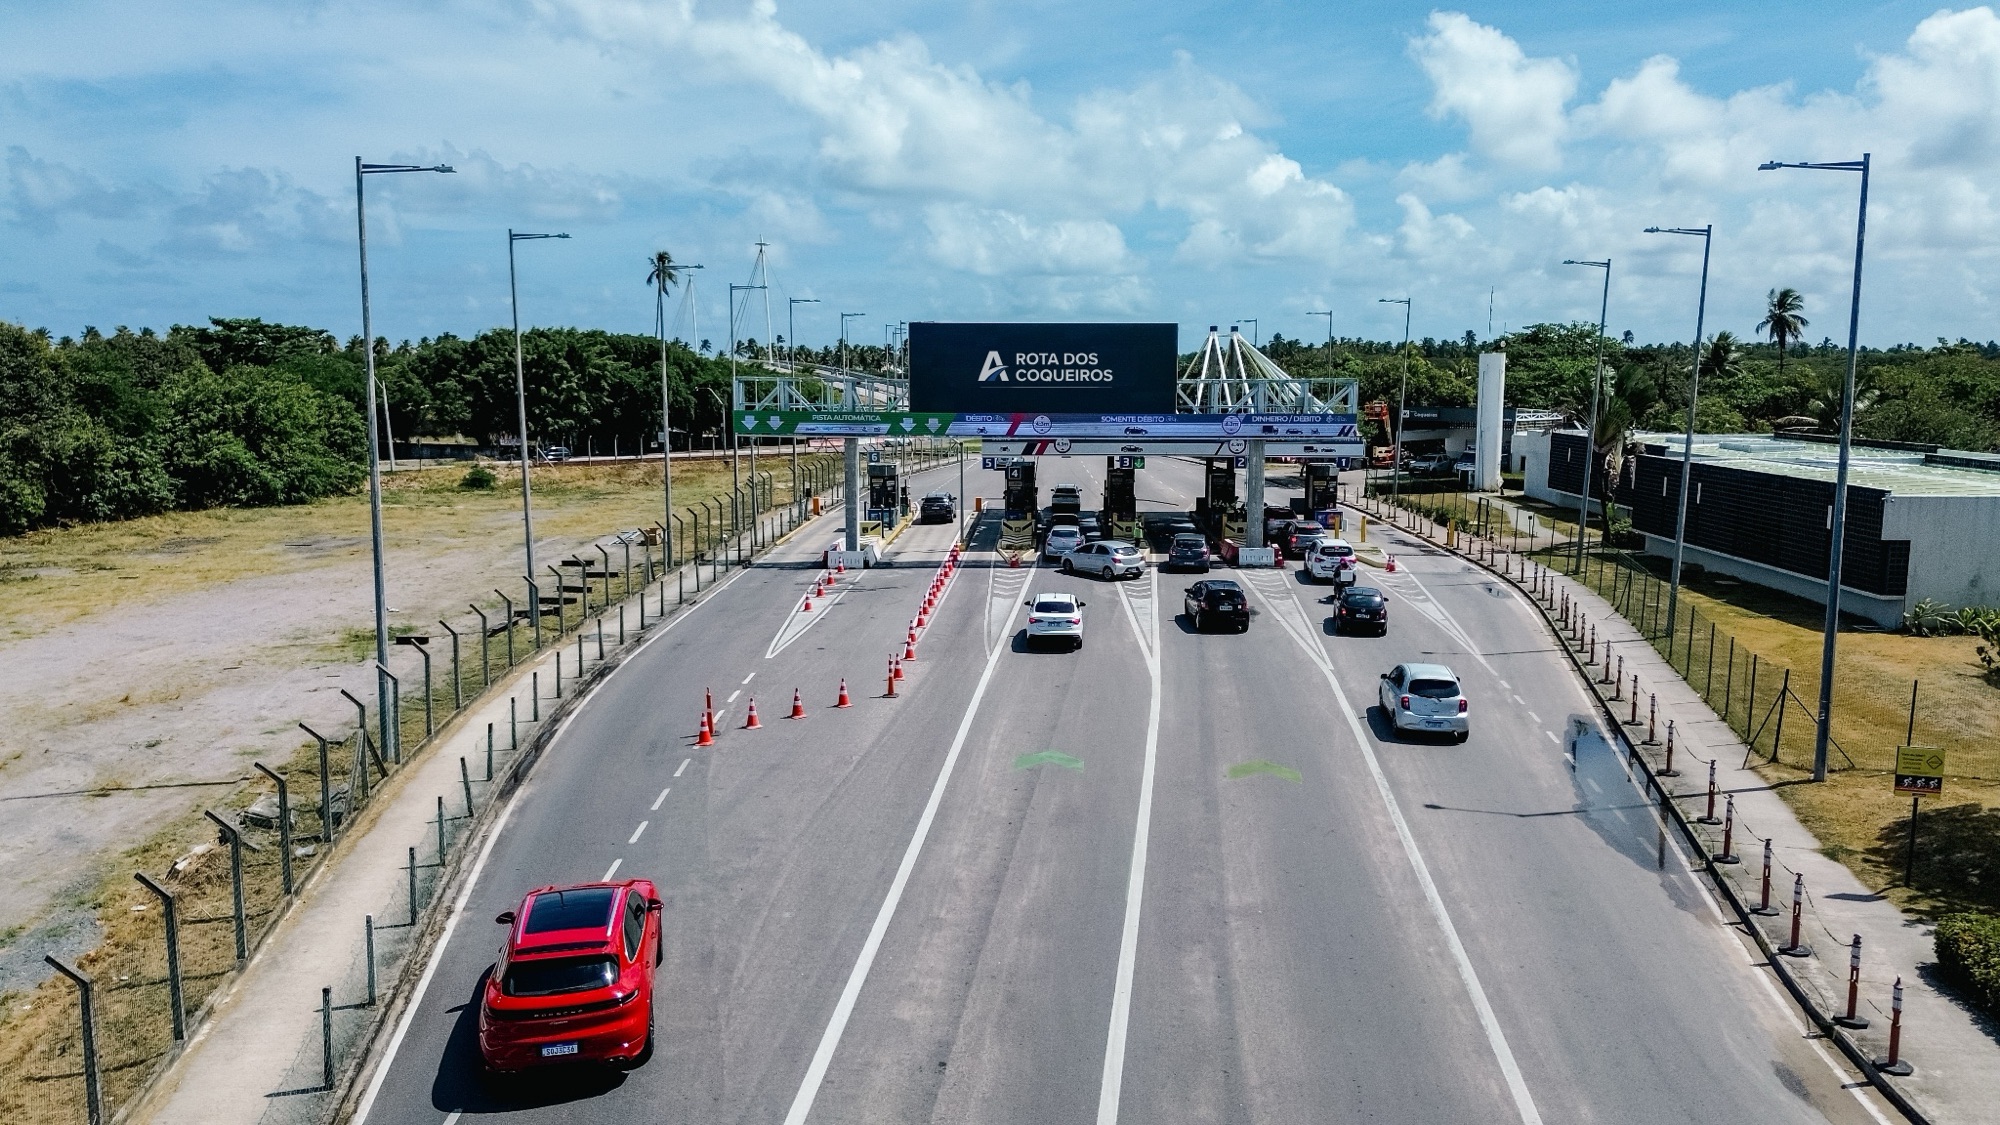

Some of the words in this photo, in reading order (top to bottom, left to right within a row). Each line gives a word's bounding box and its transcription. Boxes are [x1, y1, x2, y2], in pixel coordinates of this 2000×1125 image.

[1015, 352, 1059, 366] ROTA
[1063, 352, 1099, 366] DOS
[1015, 369, 1114, 383] COQUEIROS
[833, 413, 882, 422] AUTOMÁTICA
[965, 413, 993, 422] DÉBITO
[1100, 415, 1136, 423] SOMENTE
[1137, 414, 1165, 423] DÉBITO
[1251, 415, 1288, 423] DINHEIRO
[871, 453, 878, 462] 6
[1122, 457, 1130, 467] 3
[1237, 457, 1245, 467] 2
[985, 458, 992, 468] 5
[1341, 458, 1347, 467] 1
[1011, 469, 1019, 478] 4
